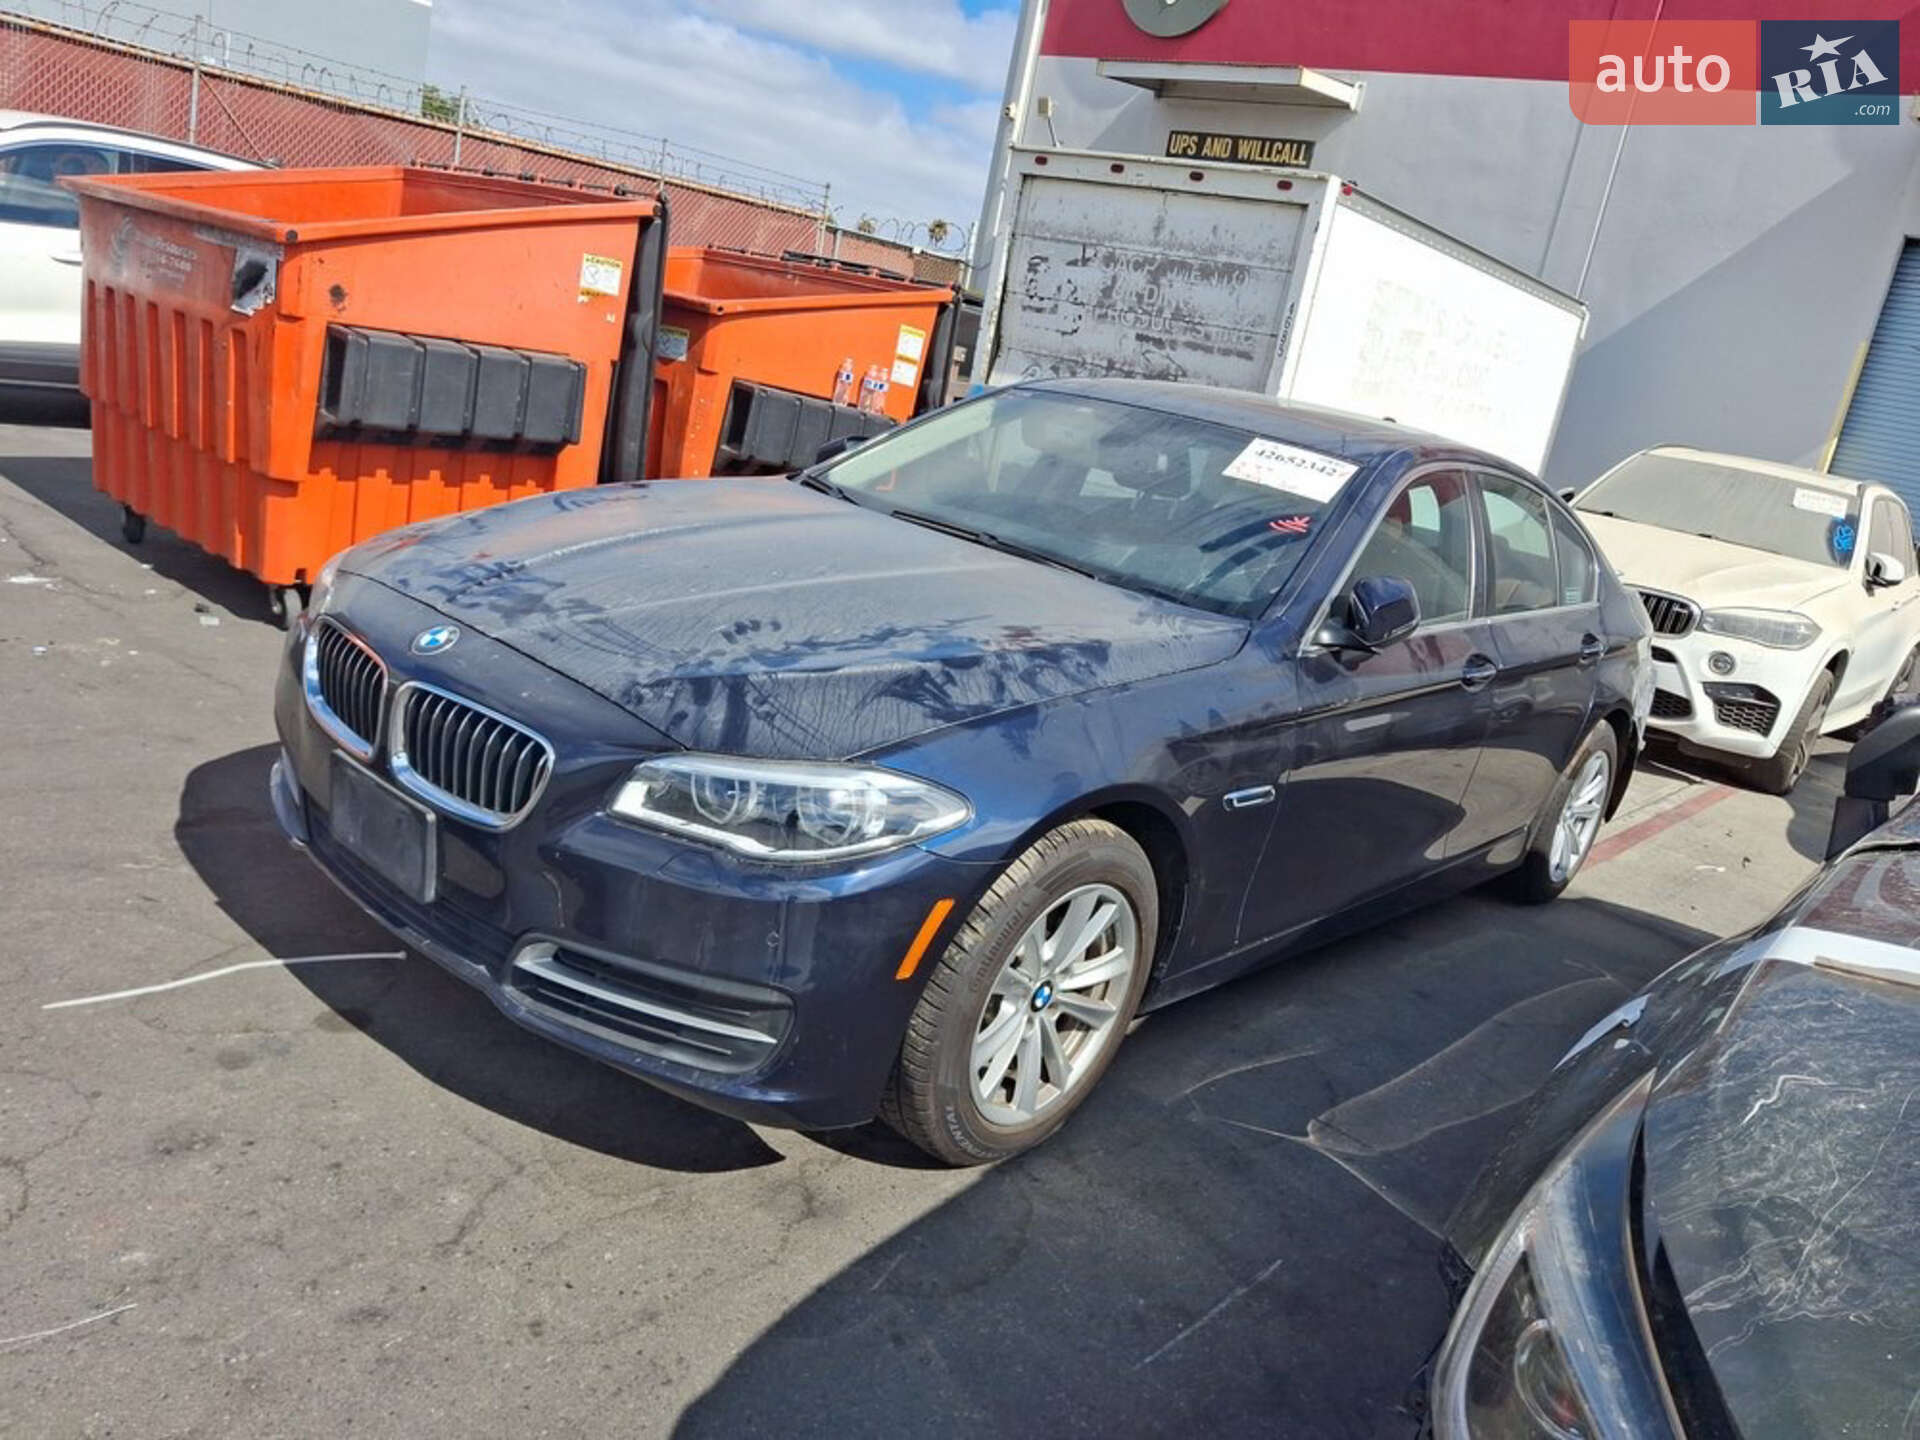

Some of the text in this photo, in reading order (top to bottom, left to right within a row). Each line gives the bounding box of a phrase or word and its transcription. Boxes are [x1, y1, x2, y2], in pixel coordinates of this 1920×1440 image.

[1169, 132, 1307, 166] UPS AND WILLCALL
